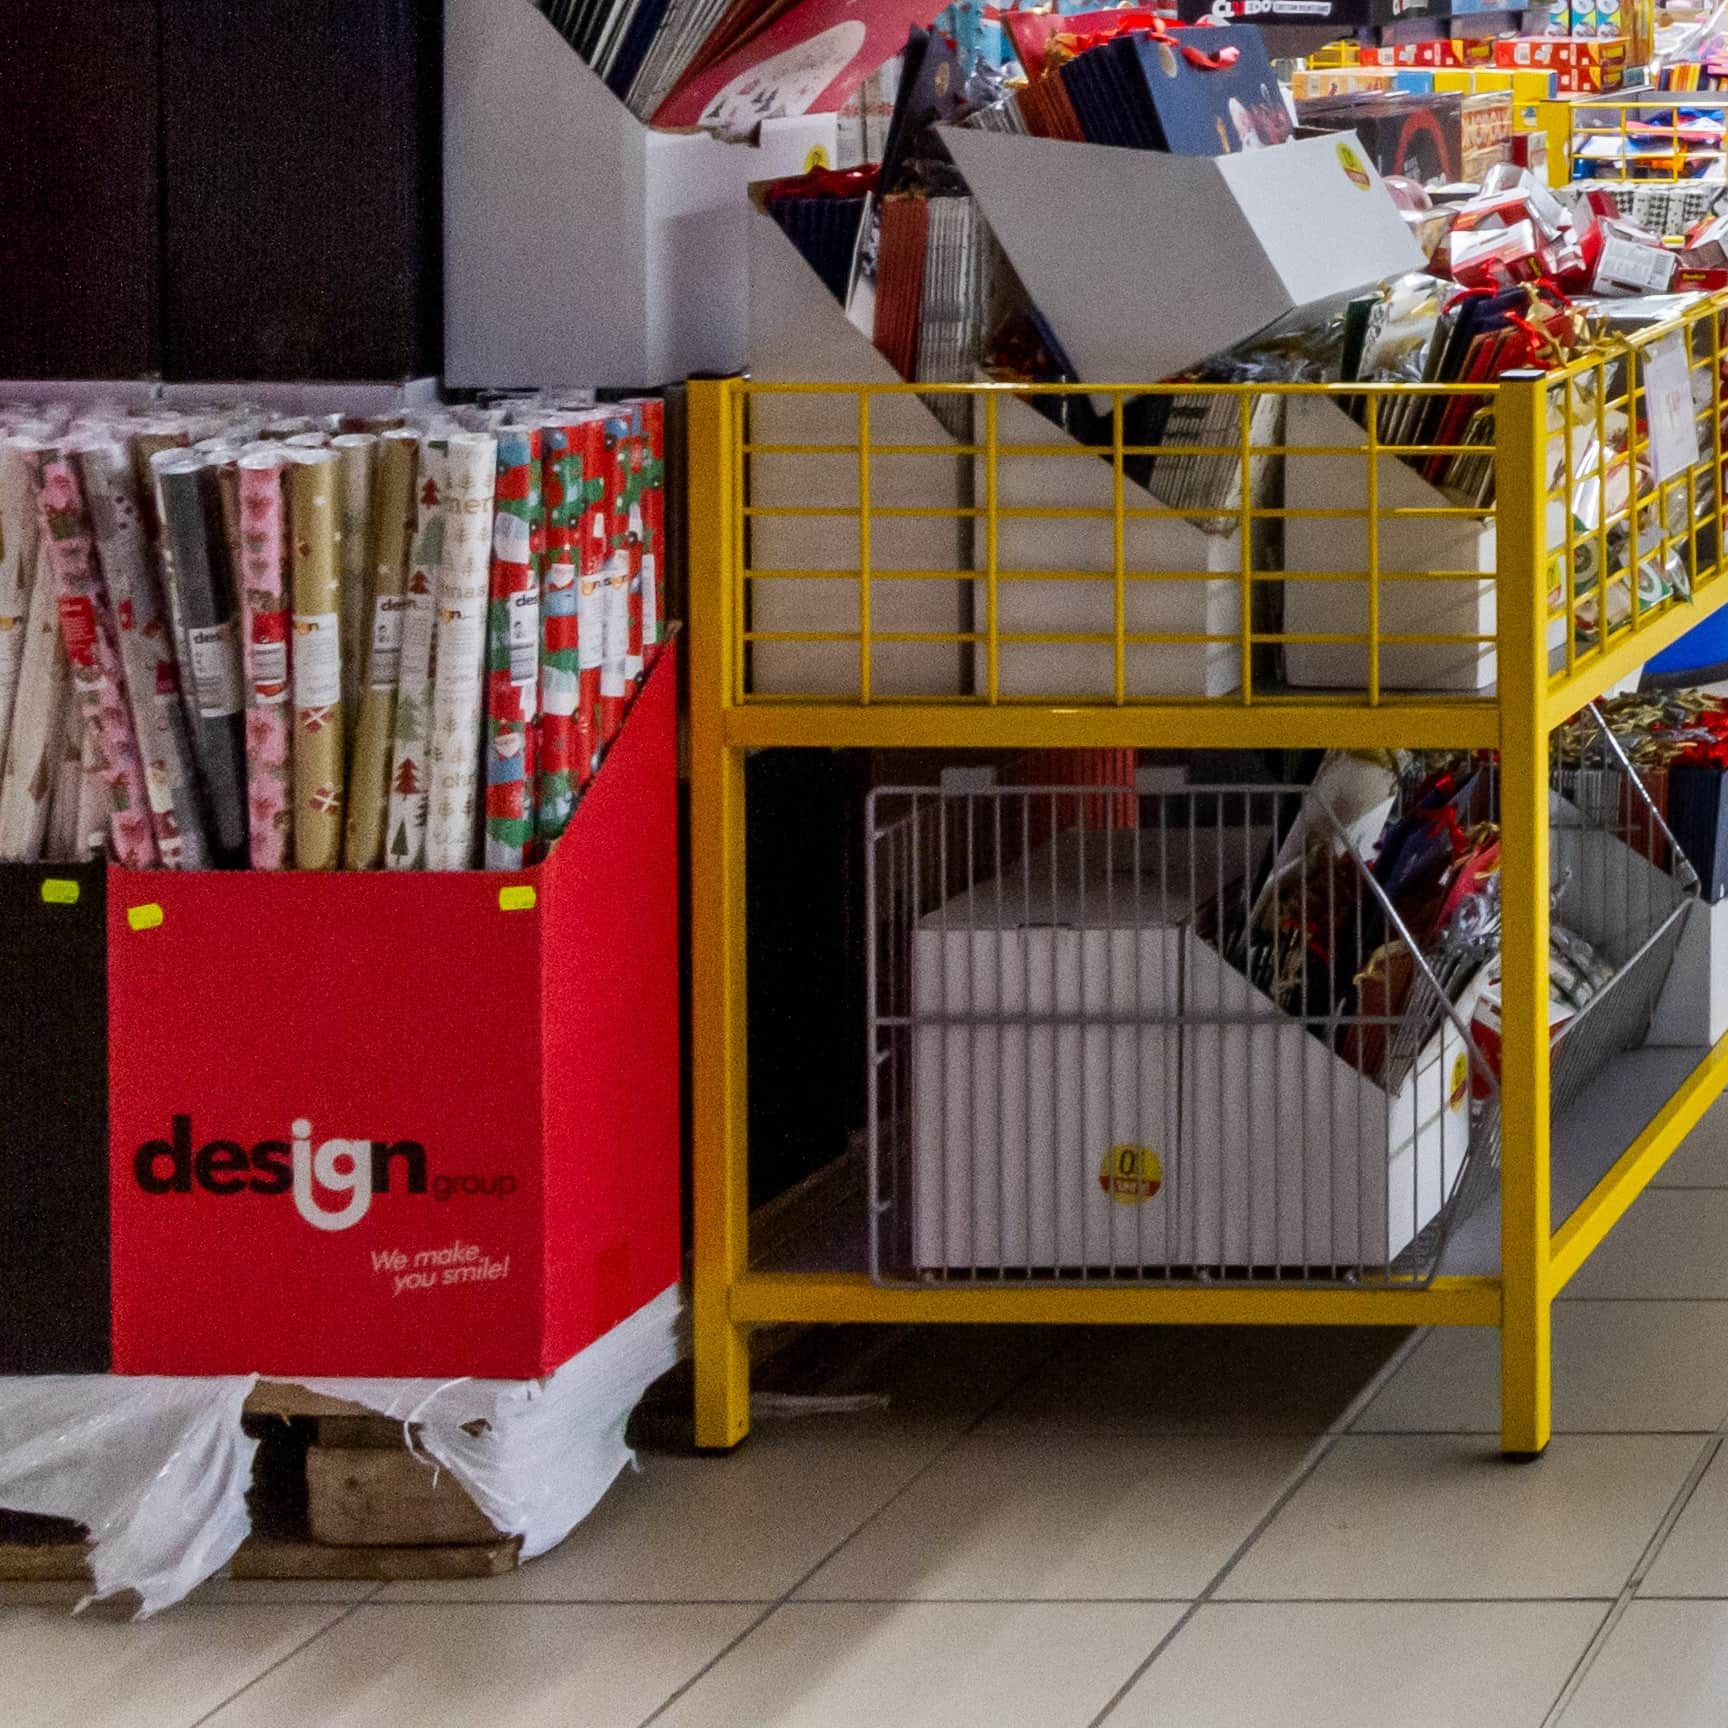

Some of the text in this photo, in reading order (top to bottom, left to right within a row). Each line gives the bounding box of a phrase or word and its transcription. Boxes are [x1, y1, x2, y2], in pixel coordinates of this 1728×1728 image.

[133, 1114, 516, 1232] design group
[371, 1241, 481, 1272] We make
[395, 1258, 510, 1296] you smile!
